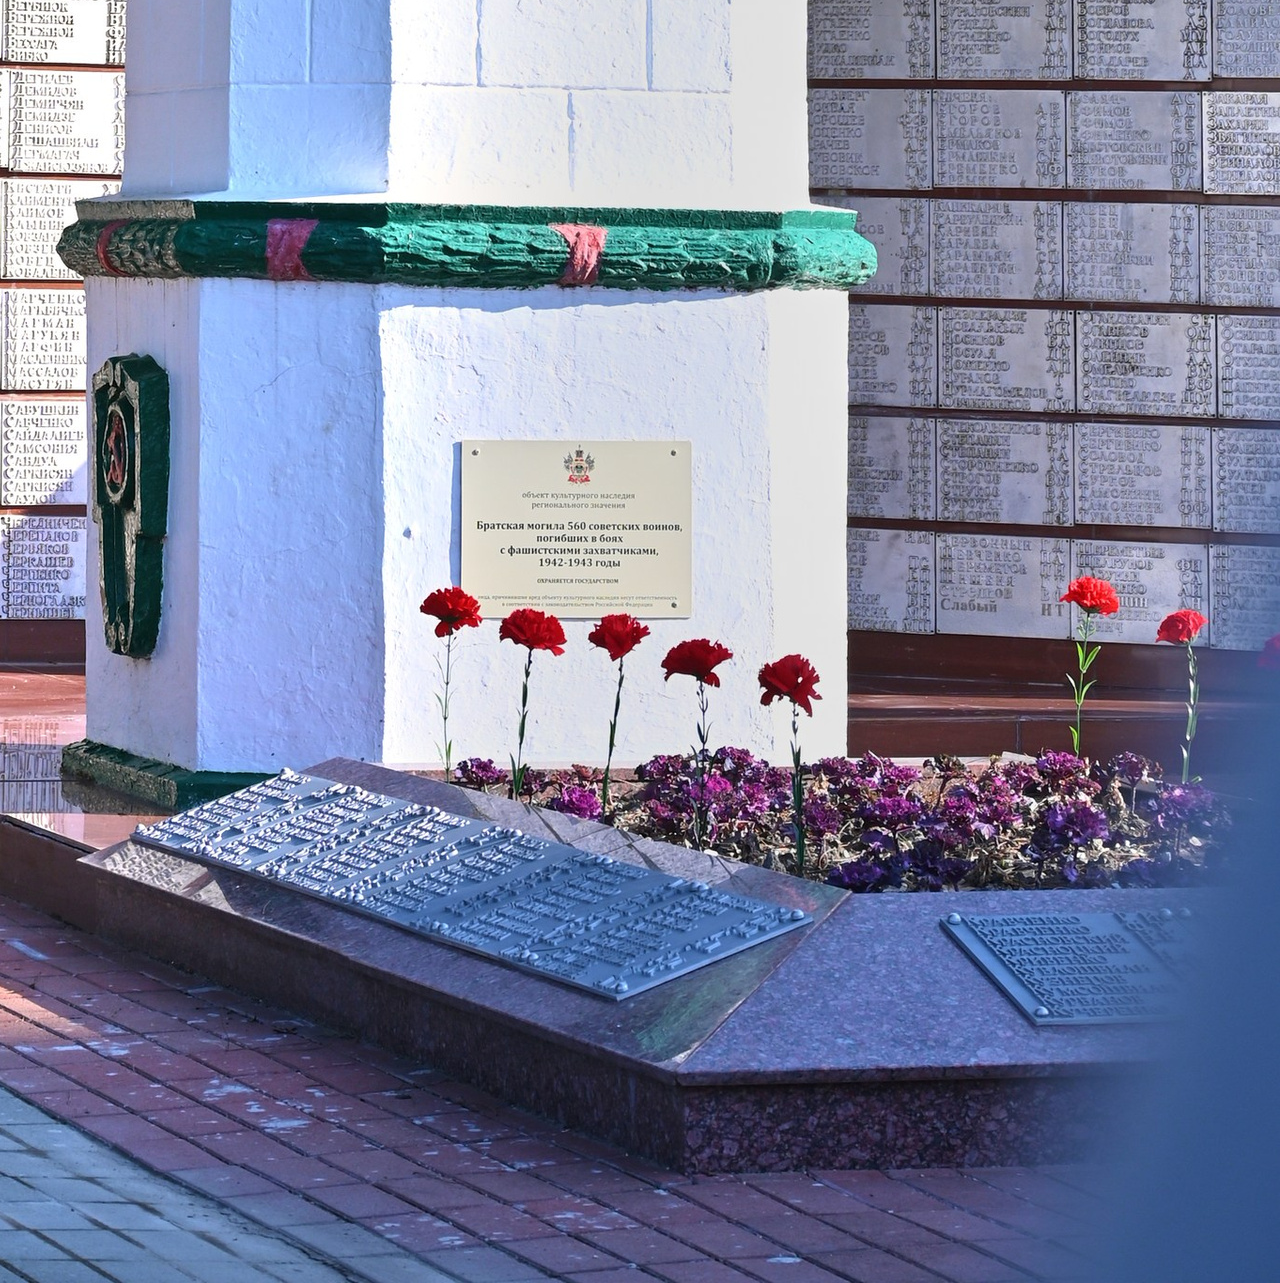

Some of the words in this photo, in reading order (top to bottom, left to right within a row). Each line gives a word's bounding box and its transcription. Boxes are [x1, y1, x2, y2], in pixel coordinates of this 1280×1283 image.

[522, 491, 549, 499] объект
[551, 492, 598, 500] культурного
[531, 502, 589, 510] регионального
[477, 521, 524, 532] Братская
[568, 521, 586, 531] 560
[589, 523, 640, 532] советских
[643, 523, 683, 532] воинов,
[536, 534, 588, 543] погибших
[591, 535, 597, 543] в
[599, 534, 623, 543] боях
[500, 547, 505, 555] с
[507, 546, 580, 557] фашистскими
[583, 547, 659, 556] захватчиками,
[539, 558, 592, 567] 1942-1943
[596, 560, 620, 568] годы
[941, 600, 998, 613] Слабый
